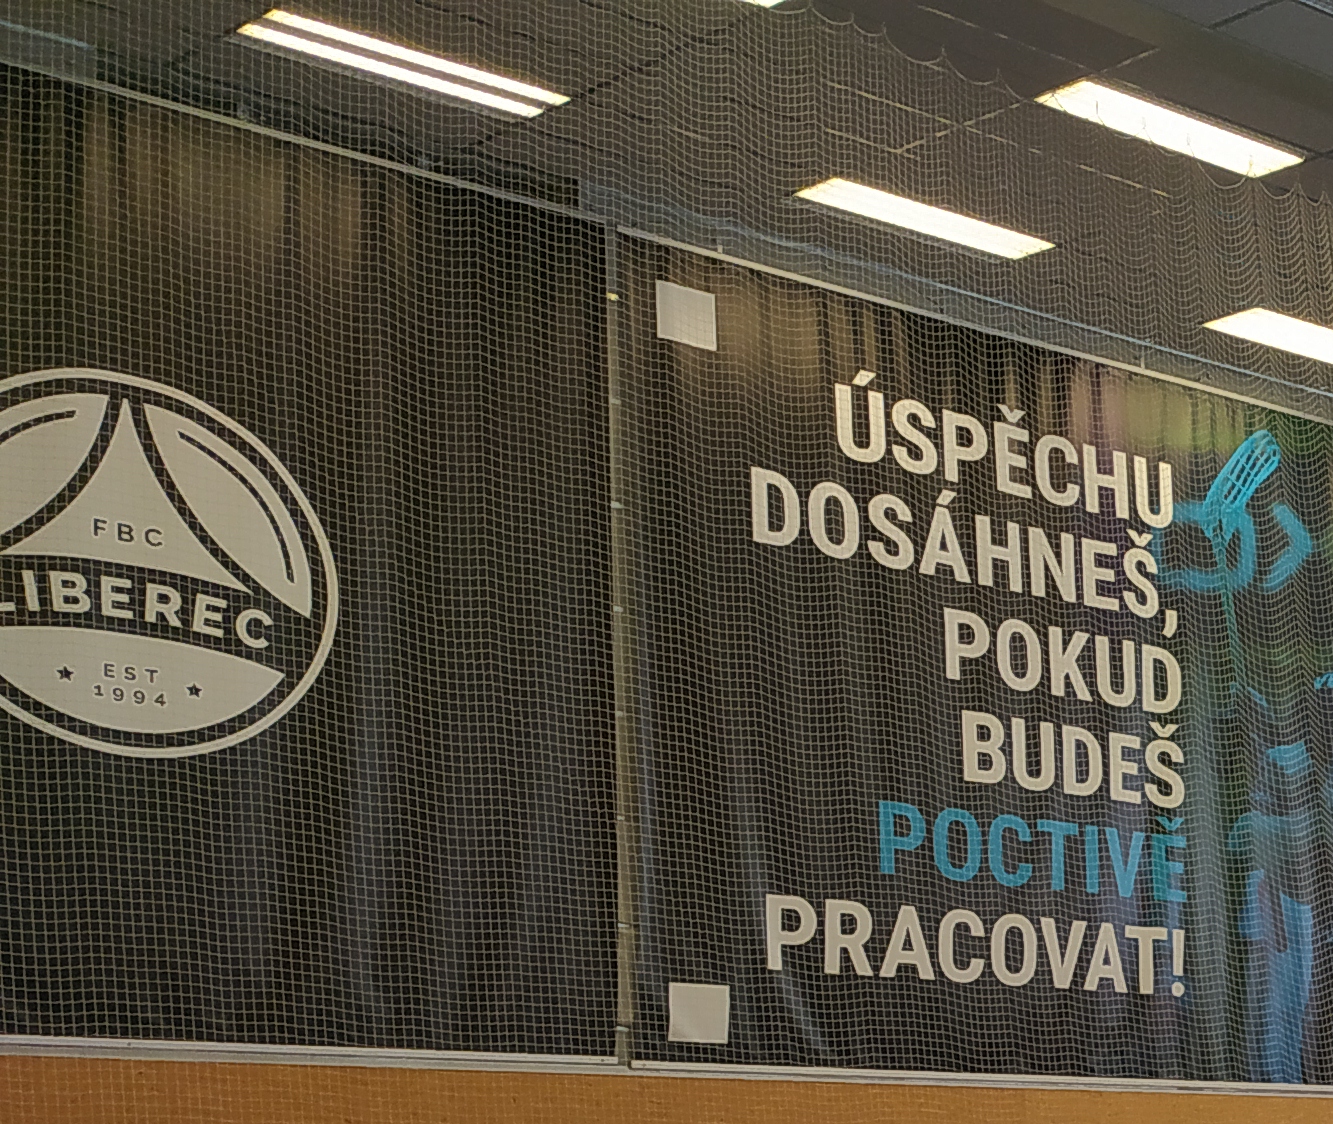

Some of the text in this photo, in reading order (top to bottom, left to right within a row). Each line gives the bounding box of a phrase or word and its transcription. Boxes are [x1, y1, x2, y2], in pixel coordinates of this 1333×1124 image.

[833, 369, 1173, 530] ÚSPĚCHU
[92, 517, 164, 548] FBC
[750, 466, 1179, 638] DOSÁHNEŠ,
[93, 684, 167, 707] 1994
[103, 662, 159, 683] EST
[944, 607, 1183, 715] POKUD
[962, 710, 1185, 809] BUDEŠ
[878, 800, 1187, 902] POCTIVĚ
[765, 893, 1185, 998] PRACOVAT!
